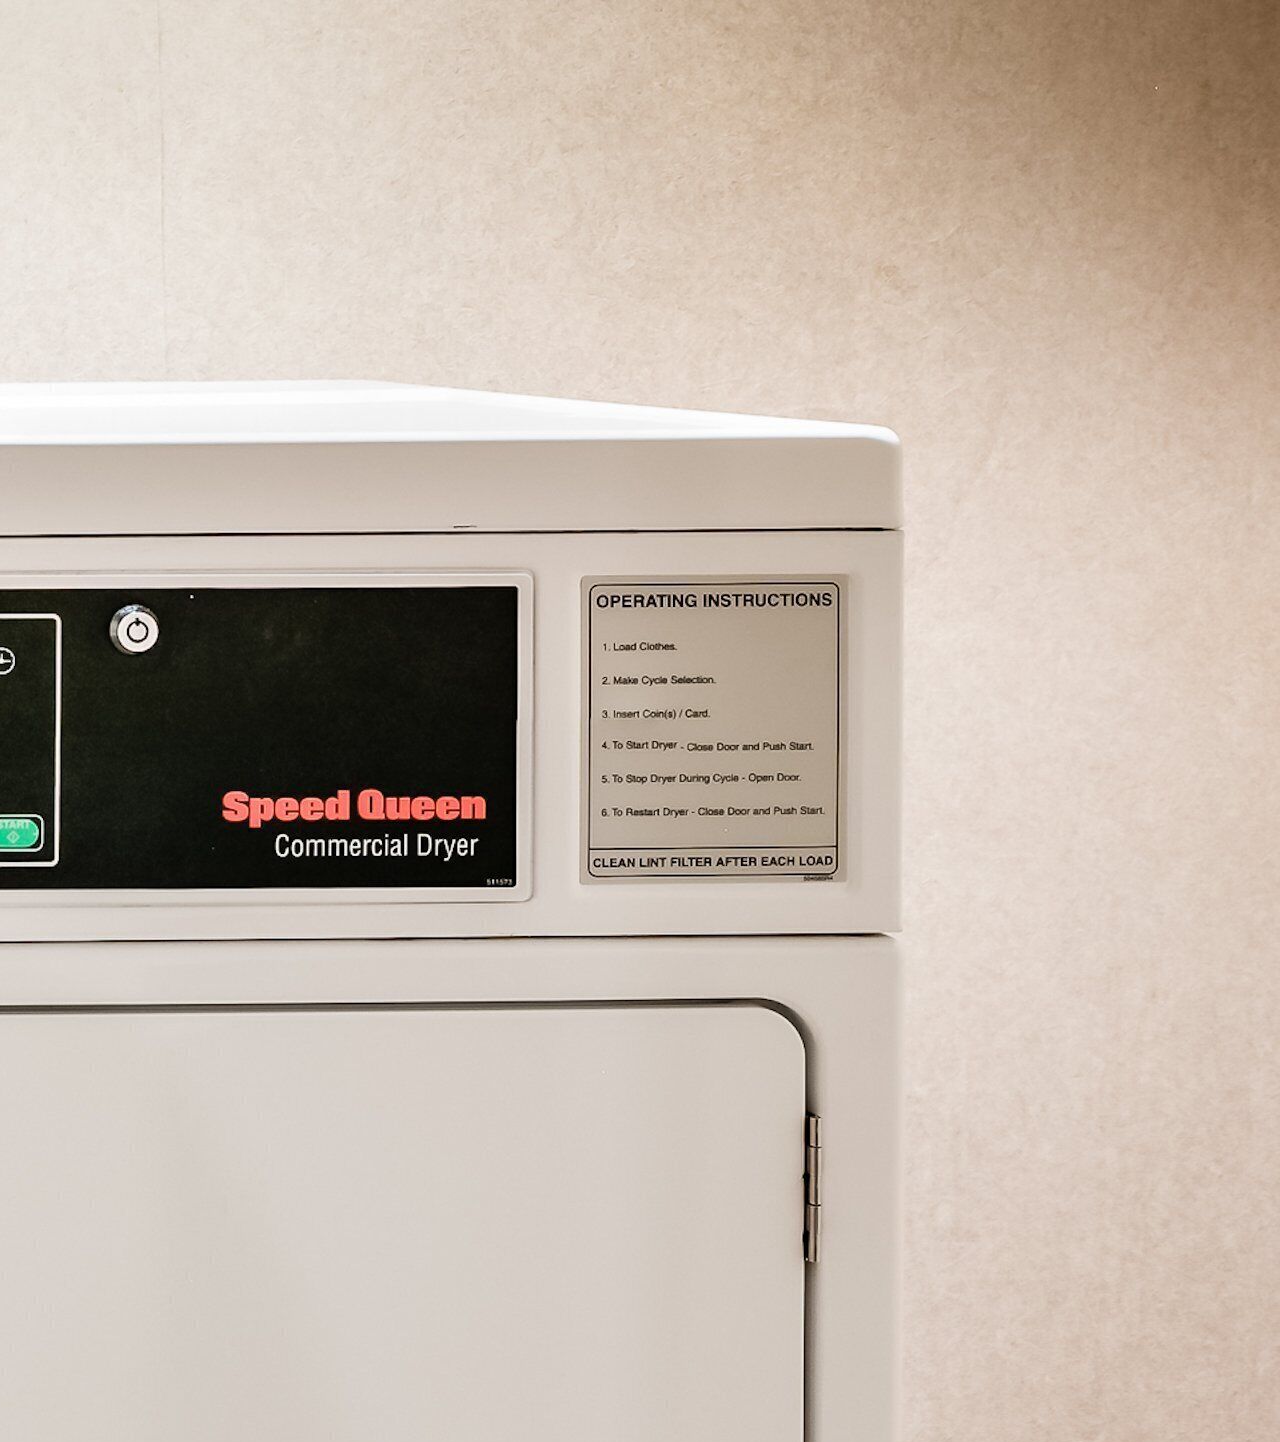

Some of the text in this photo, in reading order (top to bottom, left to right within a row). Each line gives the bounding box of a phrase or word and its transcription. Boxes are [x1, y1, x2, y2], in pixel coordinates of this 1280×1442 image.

[597, 593, 833, 608] OPERATING INSTRUCTIONS
[614, 642, 677, 651] Load Clothes.
[614, 675, 715, 686] Make Cycle Selection.
[614, 709, 710, 720] Insert Coin(s) Card.
[612, 741, 814, 751] To Start Dryer Close Door and Push Start.
[612, 773, 801, 785] To Stop Dryer During Cycle Open Door.
[222, 788, 486, 828] Speed Queen
[611, 806, 825, 818] To Restart Dryer Close Door and Push Start.
[275, 833, 479, 861] Commercial Dryer
[593, 856, 833, 868] CLEAN LINT FILTER AFTER EACH LOAD
